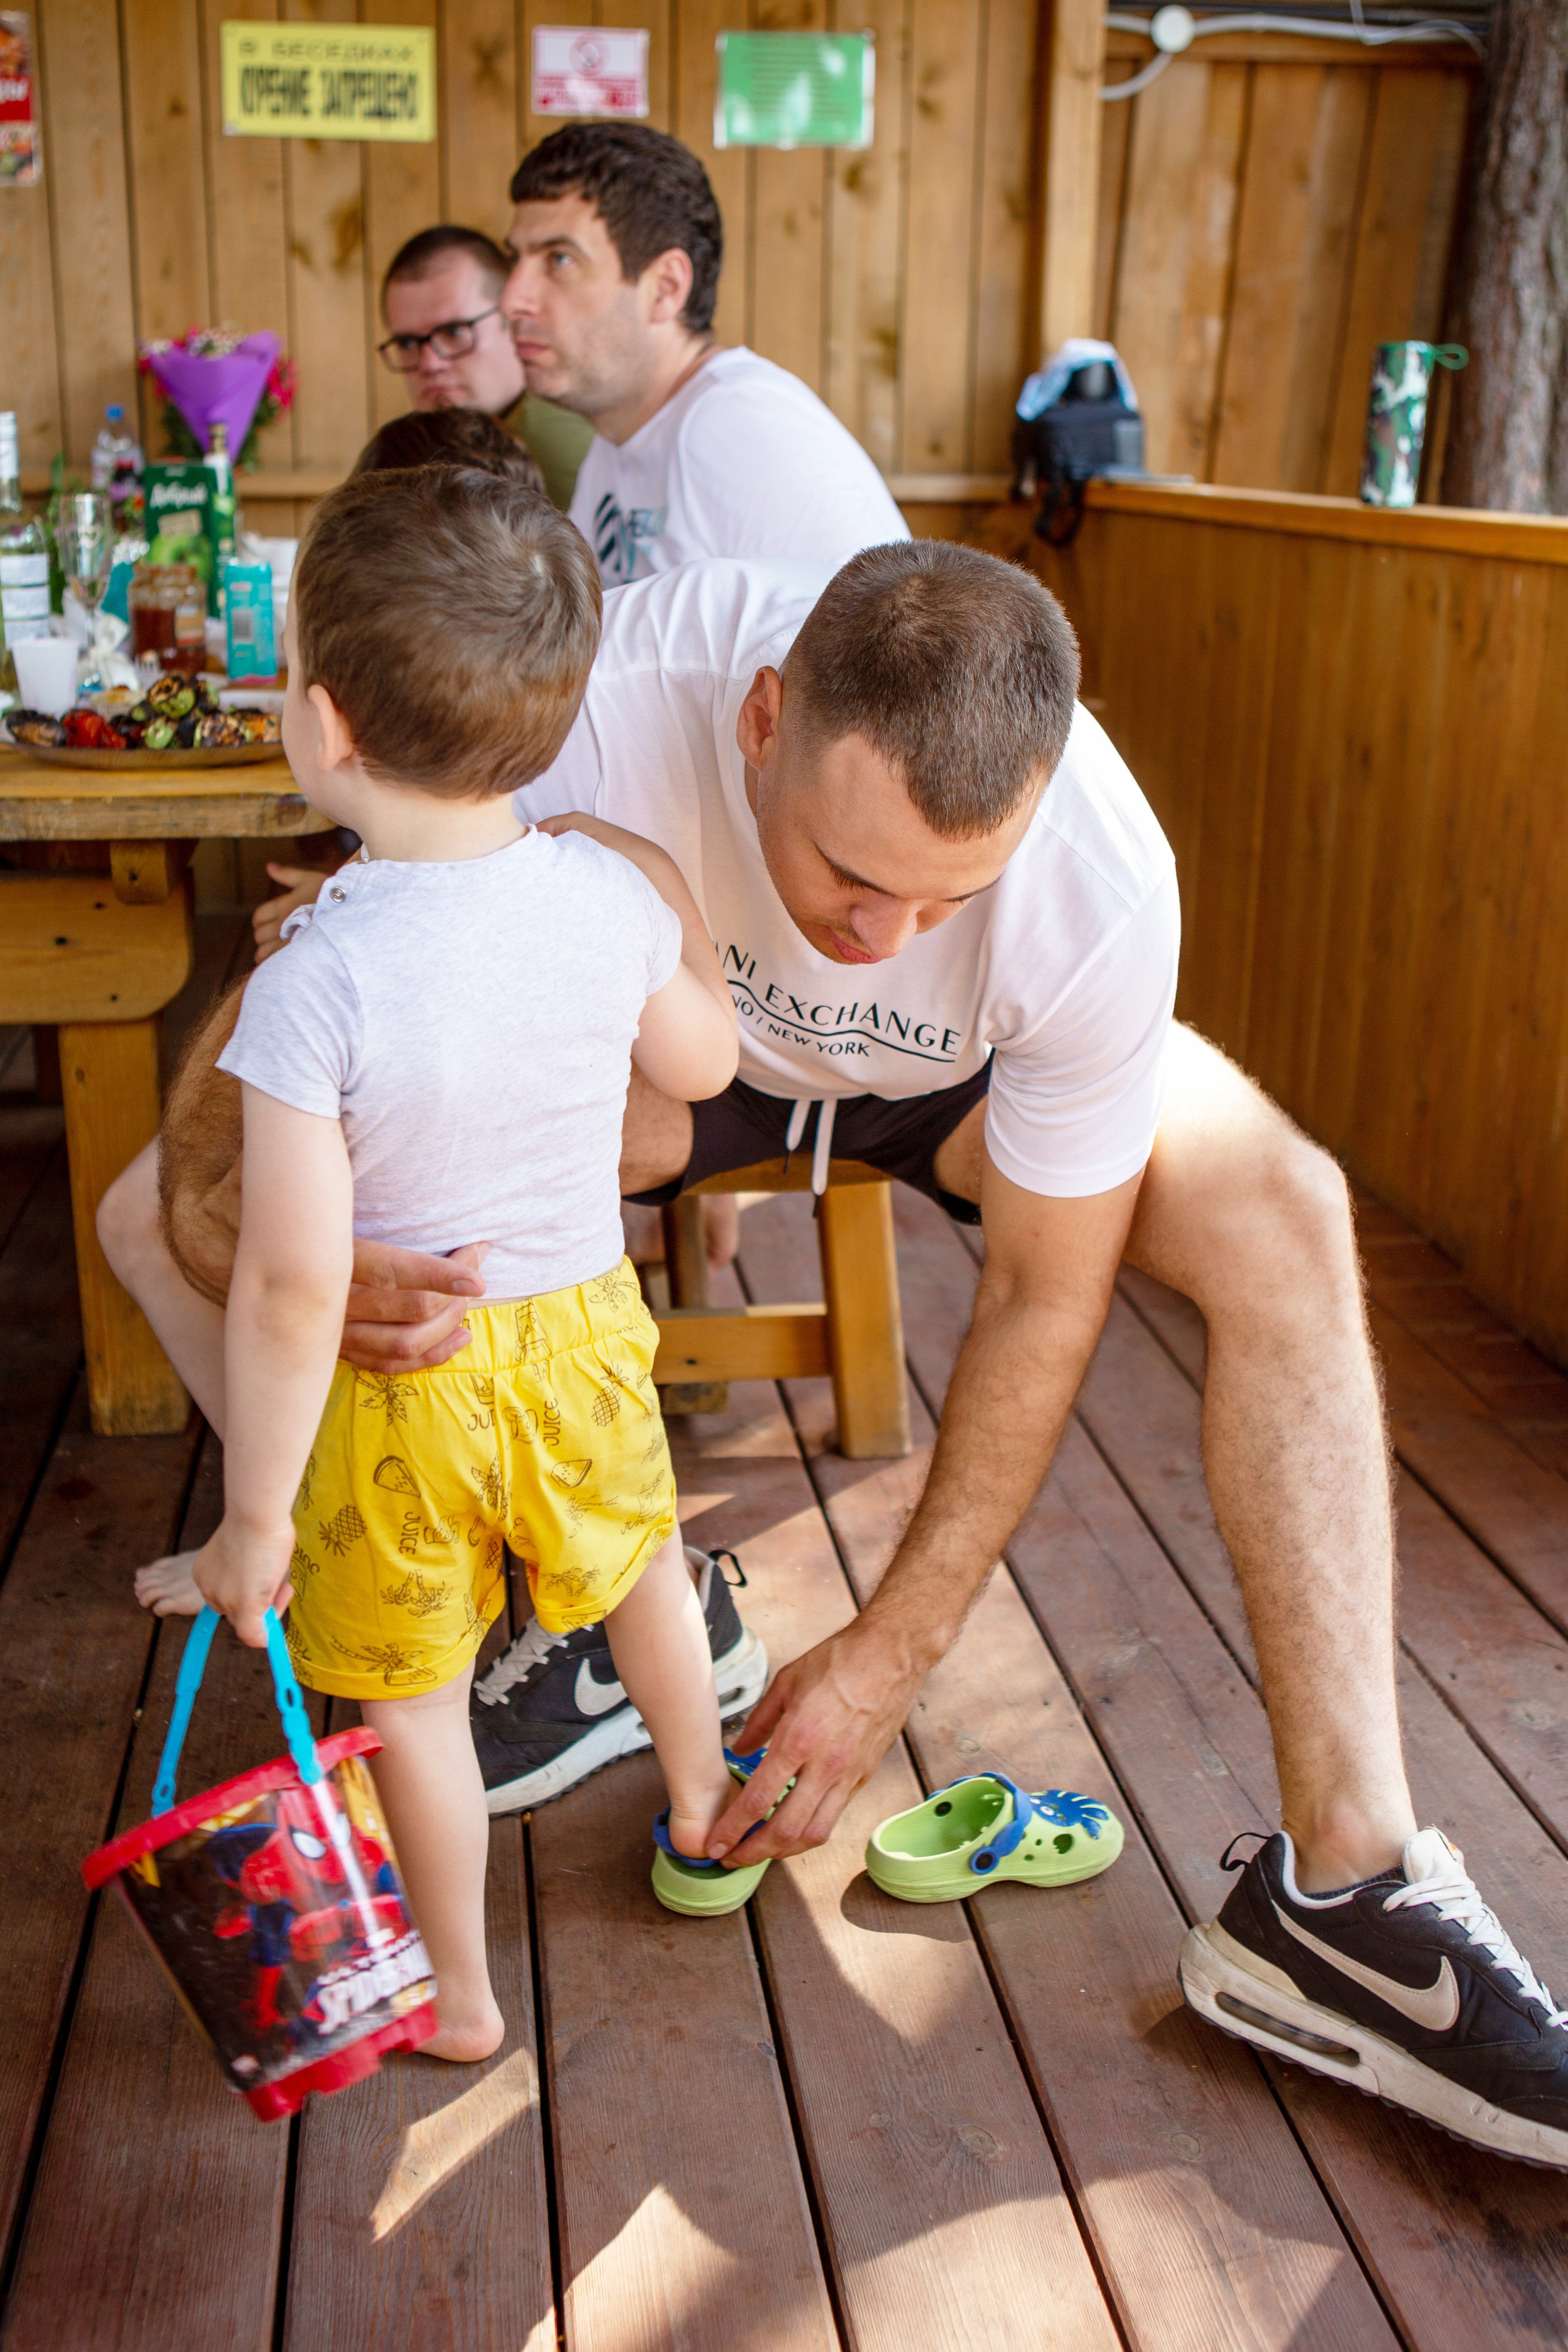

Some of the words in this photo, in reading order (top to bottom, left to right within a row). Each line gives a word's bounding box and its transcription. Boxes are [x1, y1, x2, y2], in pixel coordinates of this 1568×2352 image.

[319, 68, 419, 121] ЗАПРЕЩЕНО
[715, 941, 756, 980] NI
[765, 982, 960, 1055] EXCHANGE
[767, 1023, 811, 1046] NEW
[816, 1041, 870, 1057] YORK
[543, 1397, 560, 1446] JUICE
[398, 1511, 421, 1555] JUICE
[293, 1539, 320, 1576] JUIC
